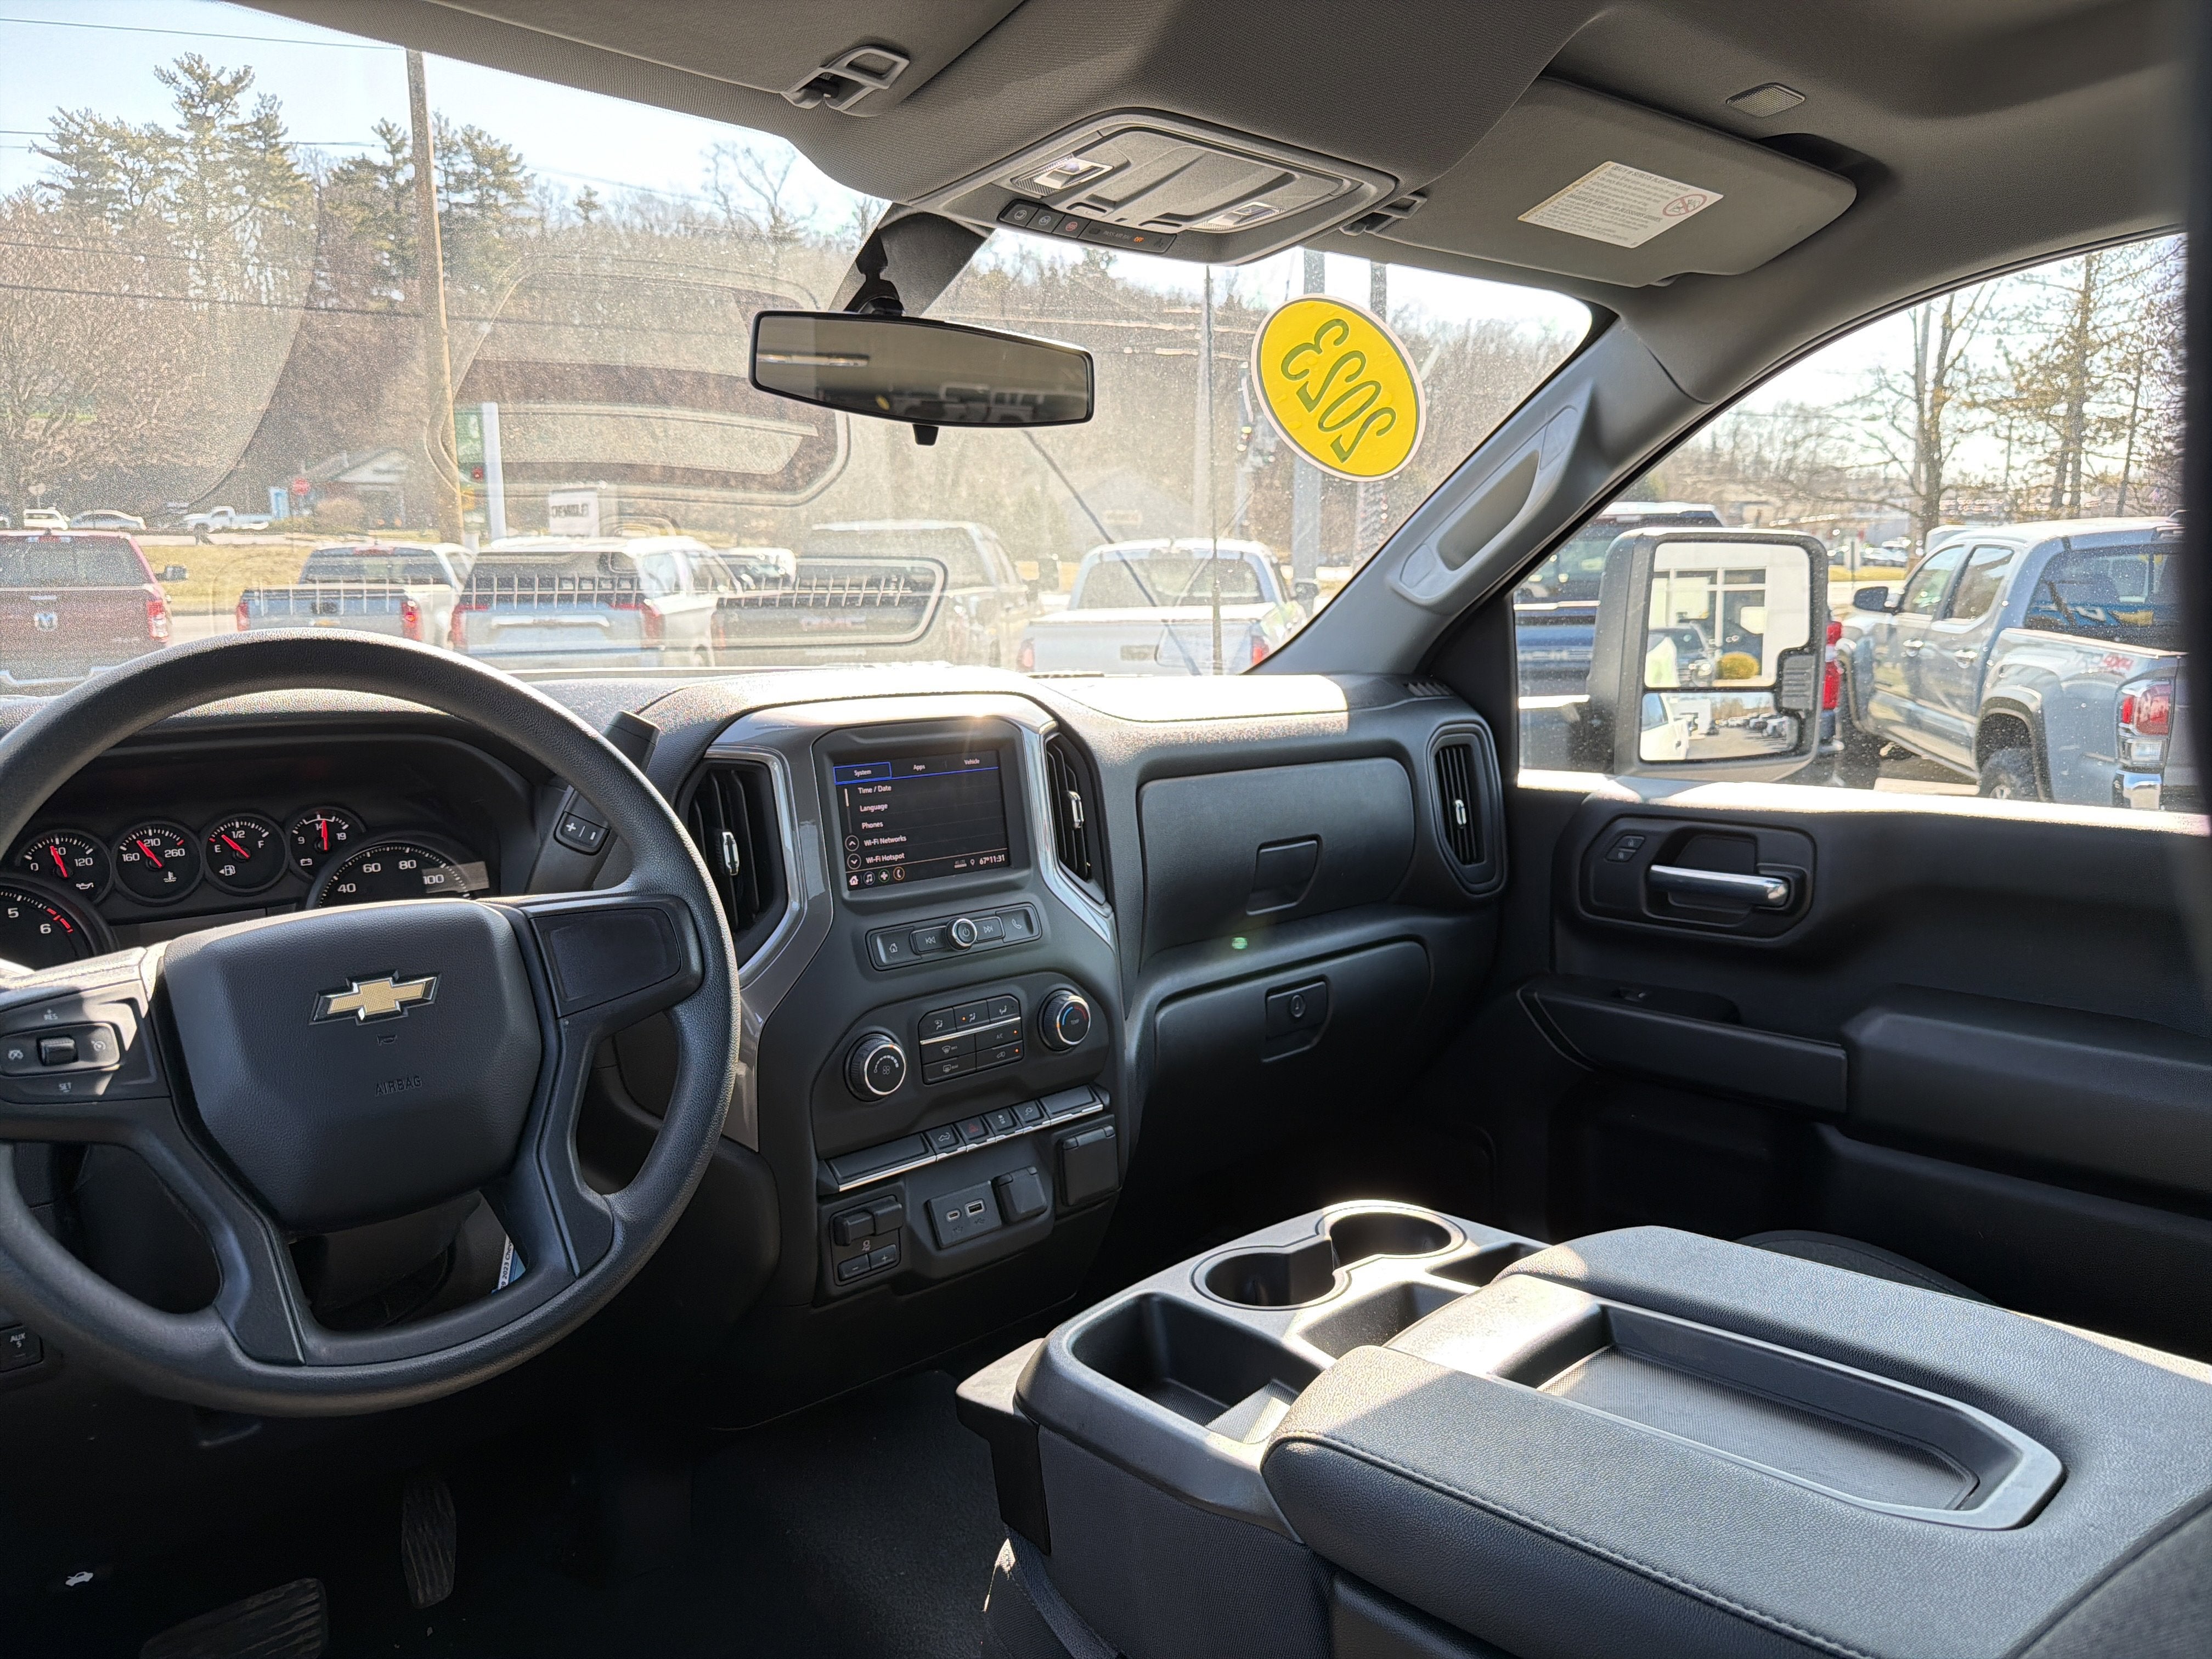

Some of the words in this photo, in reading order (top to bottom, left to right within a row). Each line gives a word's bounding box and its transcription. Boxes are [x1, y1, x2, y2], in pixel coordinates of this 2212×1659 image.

[854, 769, 872, 777] System
[860, 804, 888, 812] Language
[231, 830, 246, 839] 1/2
[336, 832, 347, 840] 19
[879, 834, 907, 844] Networks
[143, 838, 161, 847] 210
[257, 840, 264, 849] F
[297, 836, 305, 844] 9
[164, 848, 185, 857] 260
[214, 844, 222, 853] E
[74, 857, 93, 867] 120
[122, 853, 140, 862] 160
[866, 855, 881, 864] Wi-Fi
[881, 853, 905, 862] Hotspot
[30, 862, 39, 871] 0
[363, 862, 382, 873] 60
[398, 859, 417, 870] 80
[422, 874, 444, 884] 100
[337, 883, 356, 893] 40
[8, 907, 19, 918] 5
[40, 923, 52, 934] 6
[375, 1075, 422, 1095] AIRBAG
[10, 1332, 25, 1342] AUX
